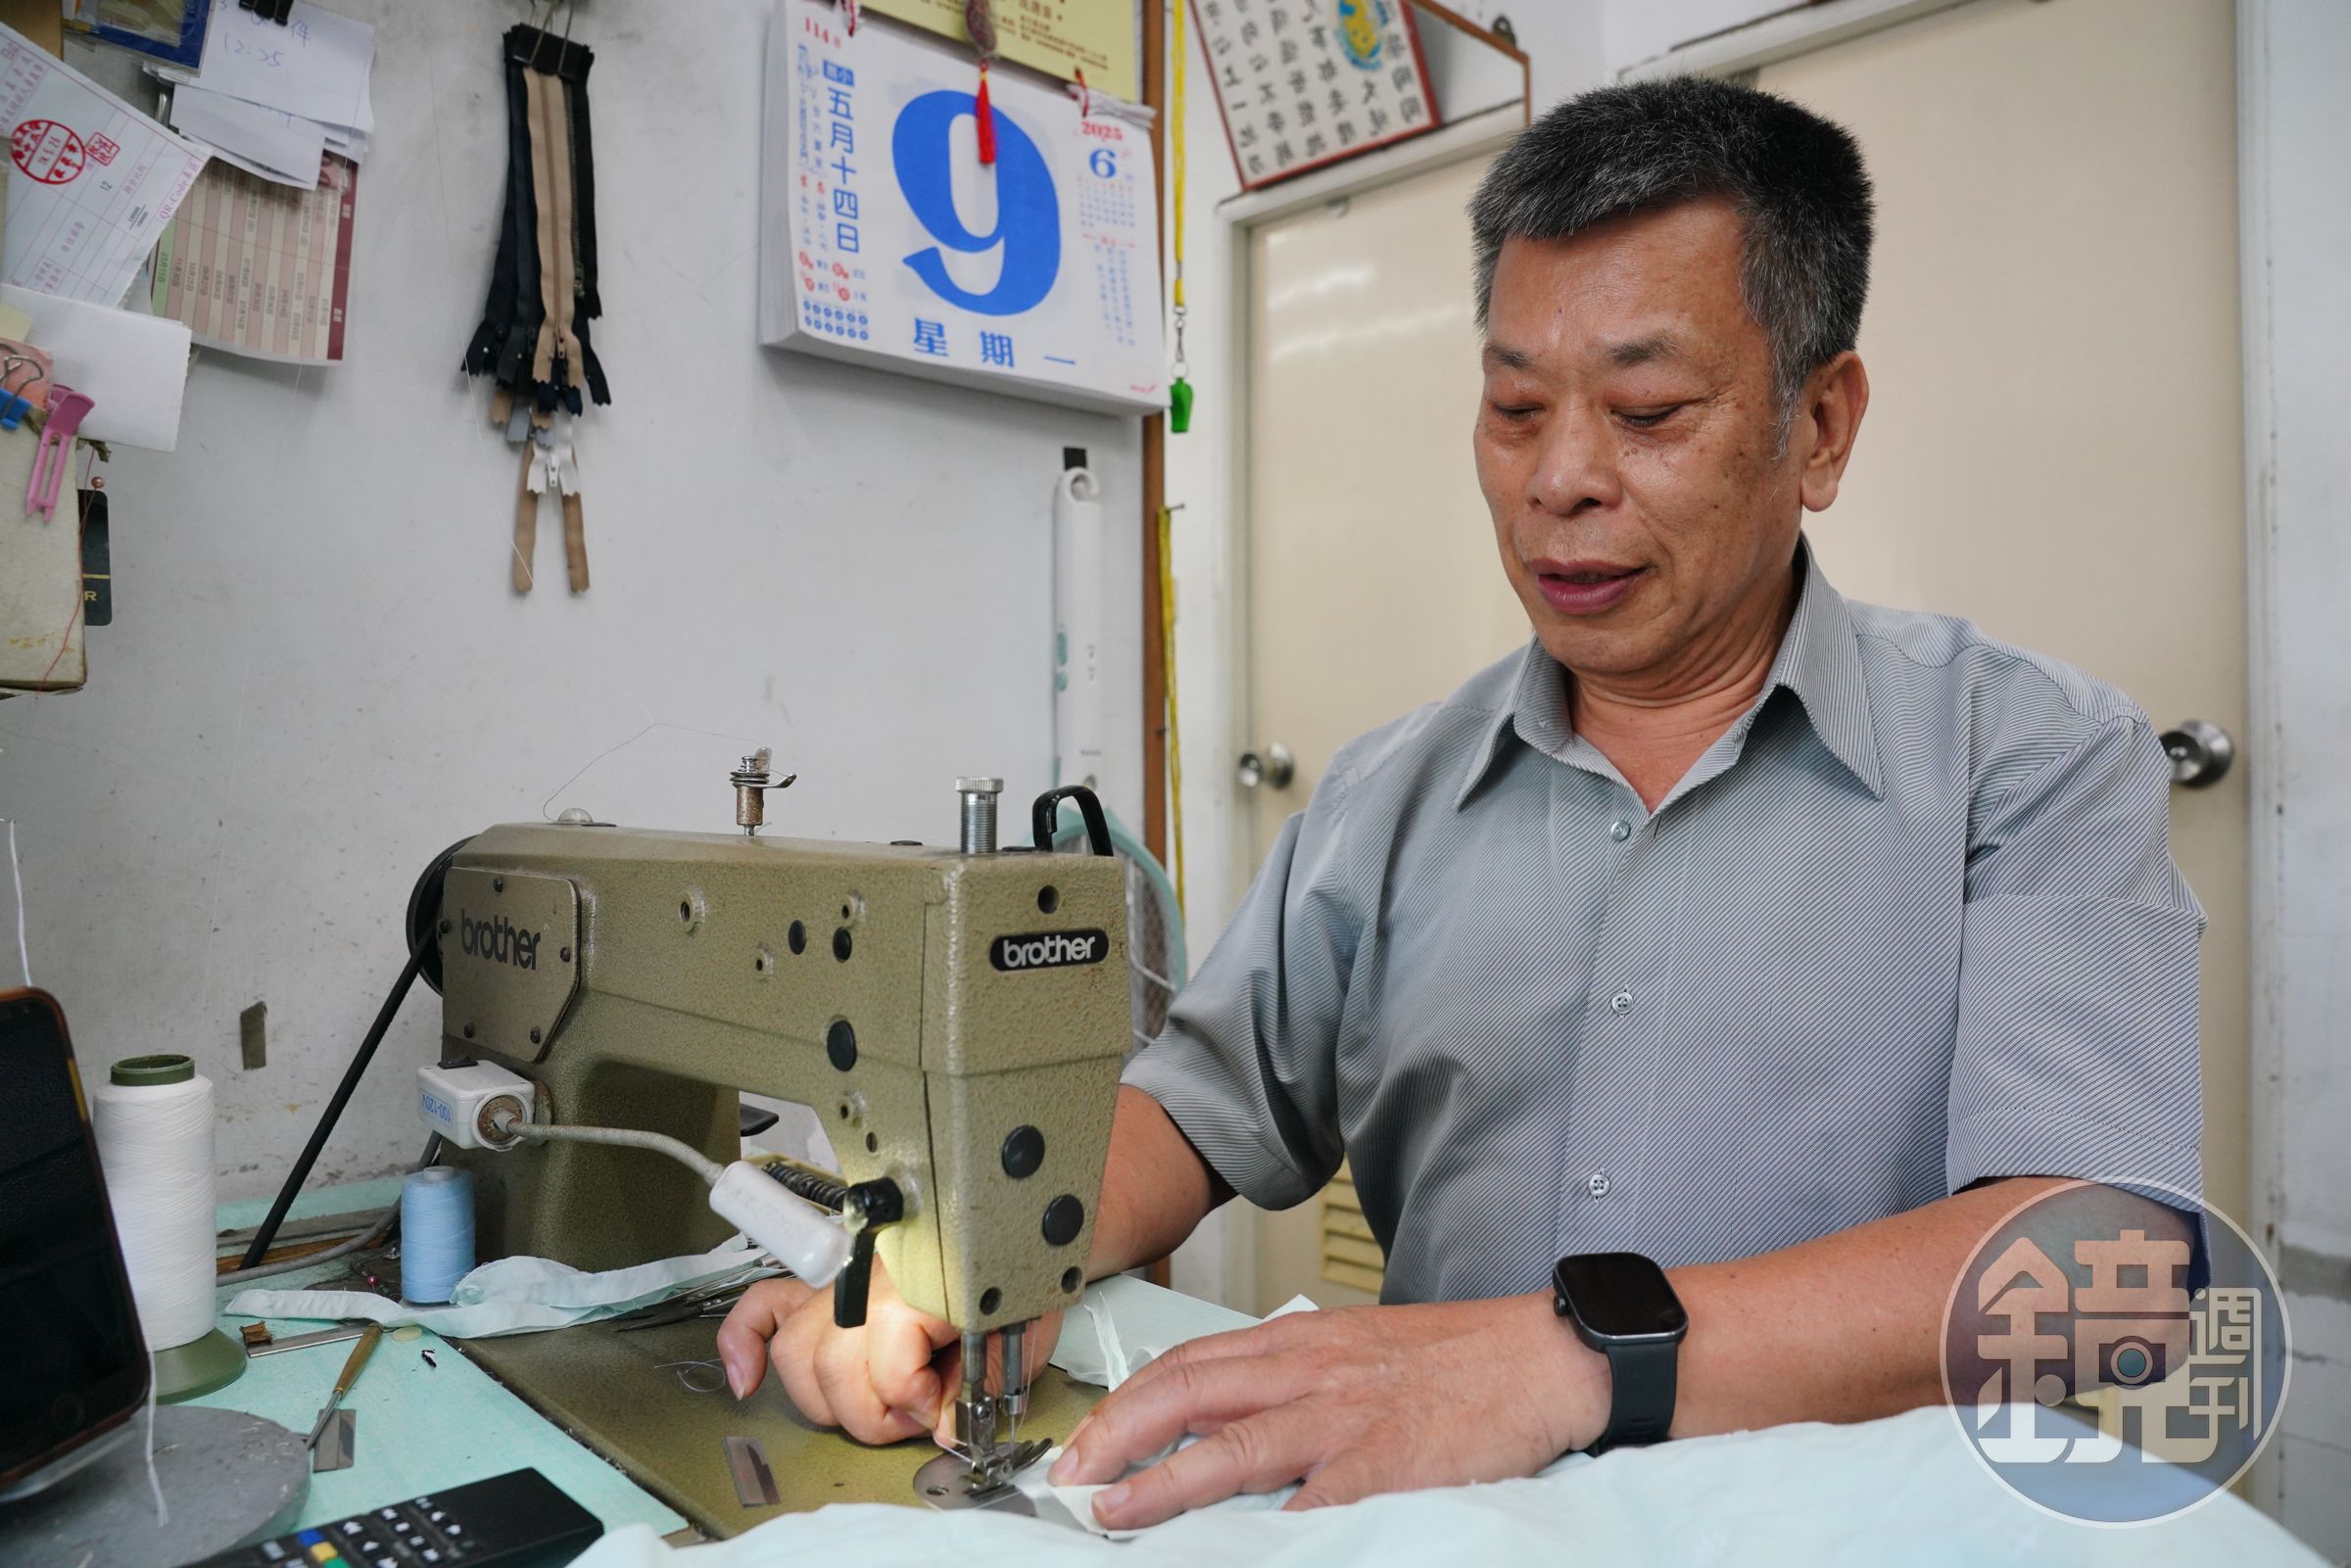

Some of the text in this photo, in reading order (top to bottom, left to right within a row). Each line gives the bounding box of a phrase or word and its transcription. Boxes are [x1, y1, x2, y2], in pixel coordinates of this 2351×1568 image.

[828, 86, 859, 254] 五月十四日
[1089, 148, 1116, 179] 6
[891, 89, 1061, 317] 9
[913, 317, 1077, 368] 星期一
[460, 908, 542, 970] brother
[1003, 934, 1096, 968] brother
